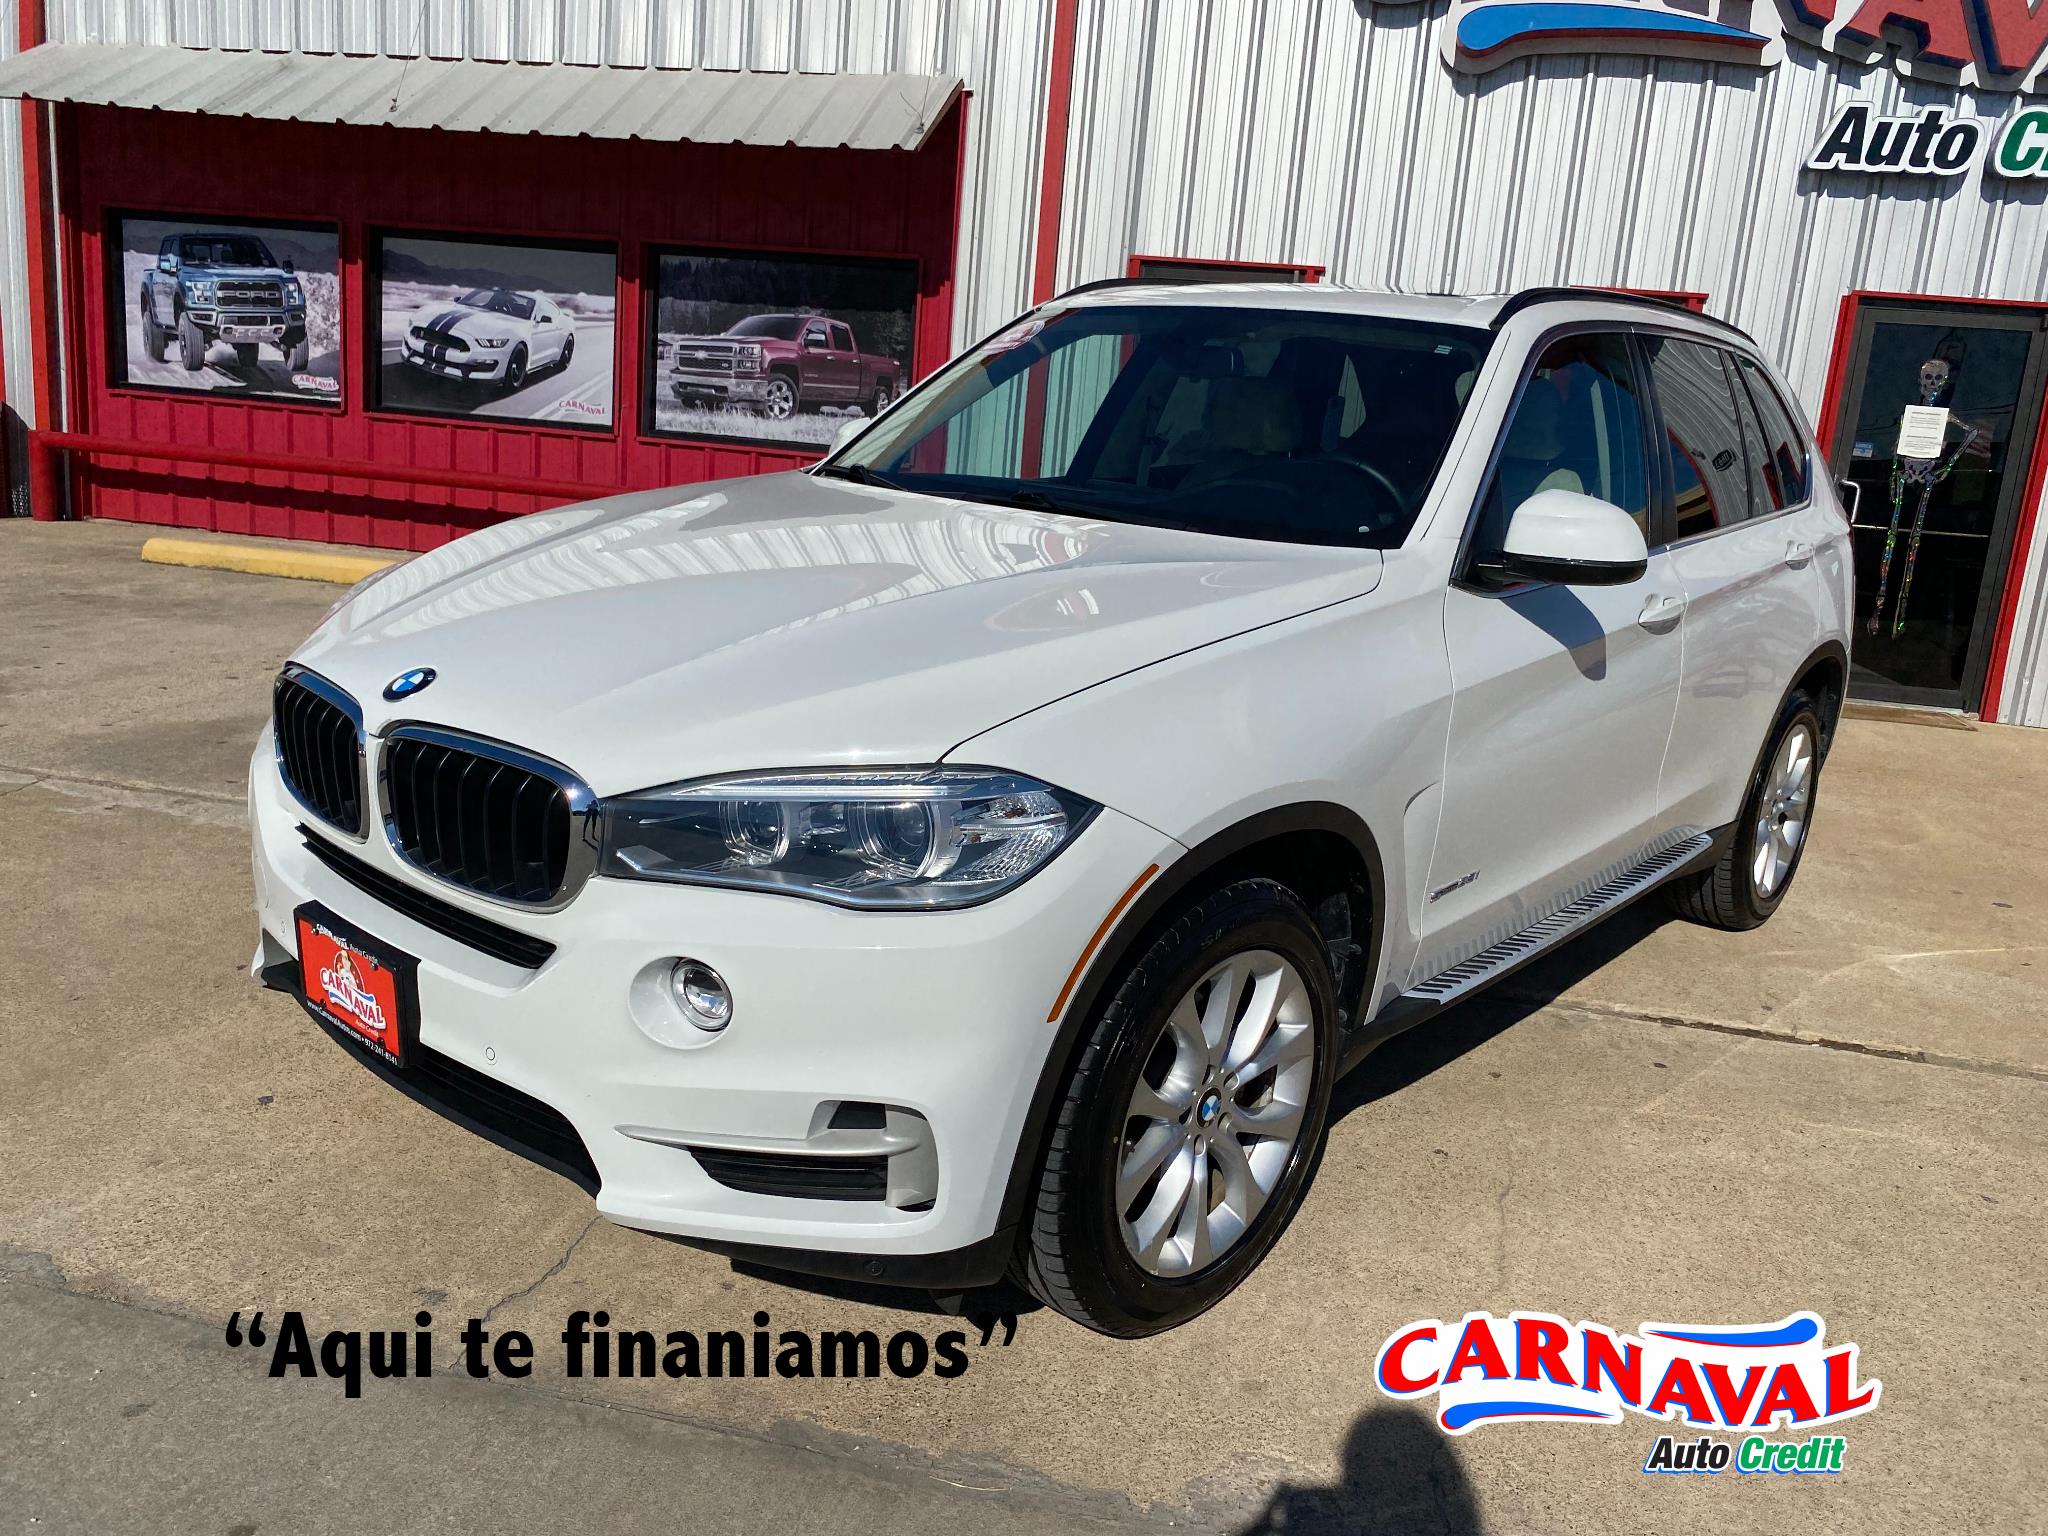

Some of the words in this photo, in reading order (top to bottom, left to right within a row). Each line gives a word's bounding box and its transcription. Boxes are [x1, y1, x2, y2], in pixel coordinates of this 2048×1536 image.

[1814, 106, 1979, 167] Auto
[293, 375, 338, 389] CARNAVAL
[559, 400, 607, 415] CARNAVAL
[320, 969, 384, 1024] CARNAVAL
